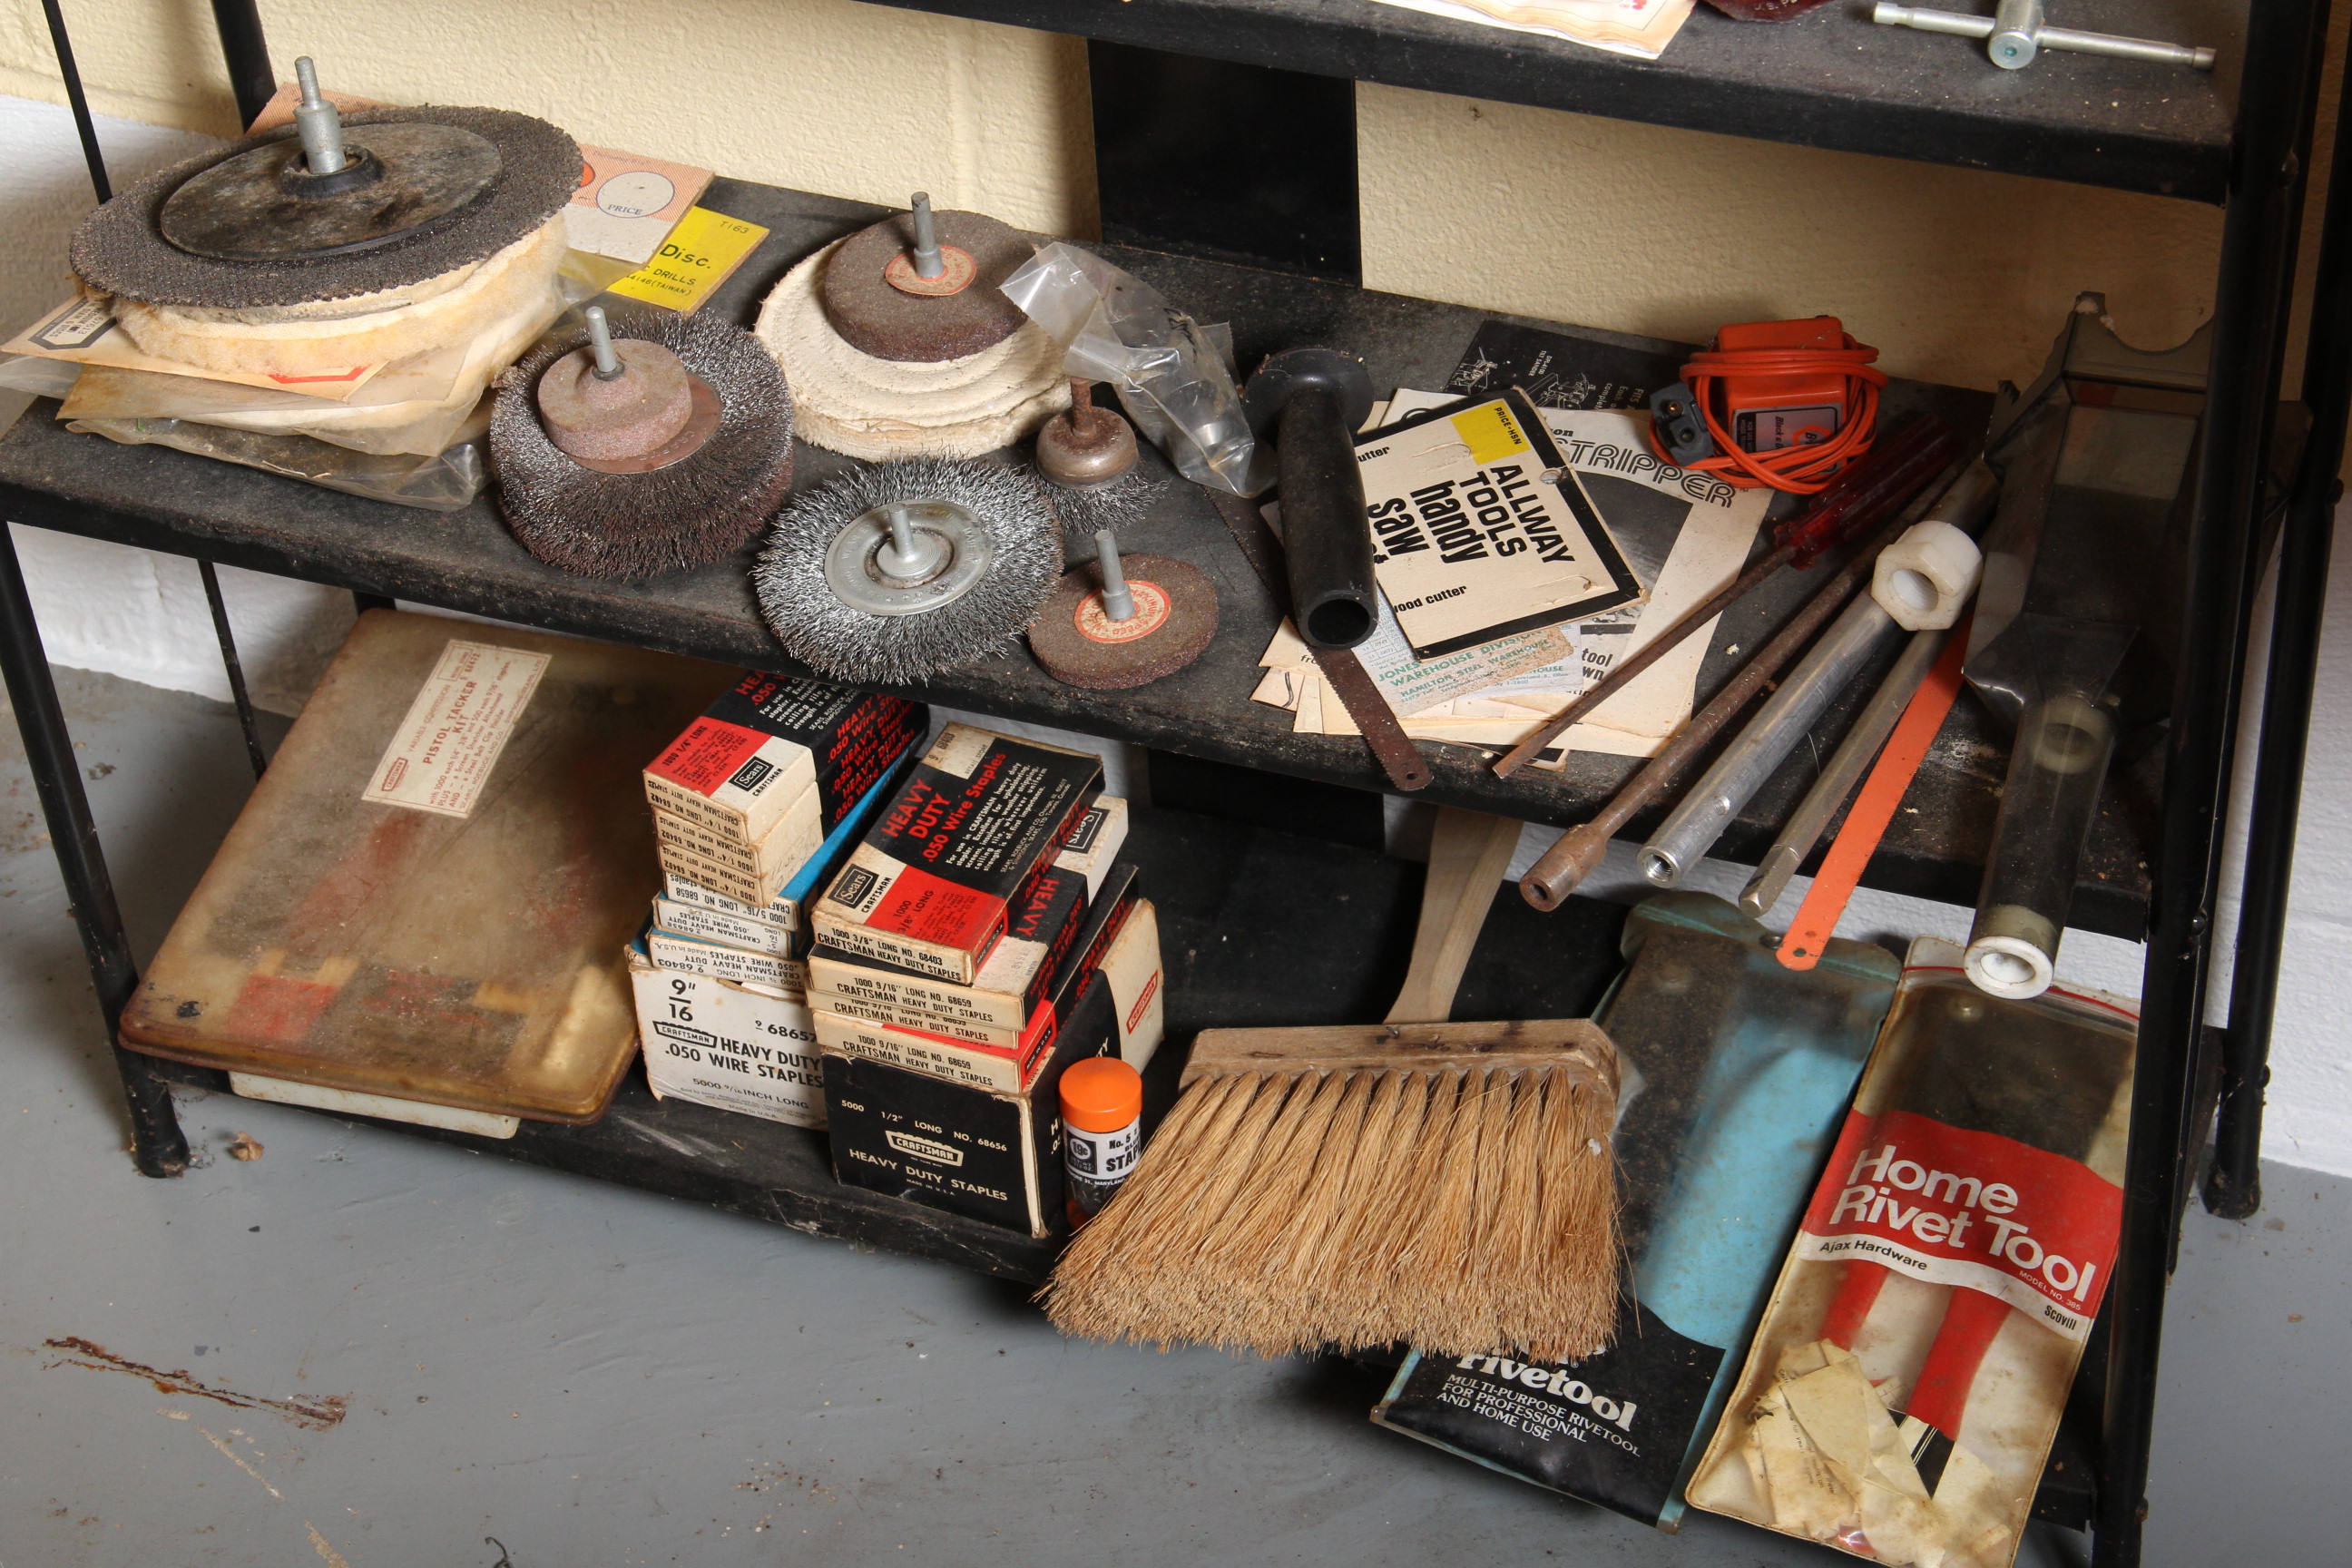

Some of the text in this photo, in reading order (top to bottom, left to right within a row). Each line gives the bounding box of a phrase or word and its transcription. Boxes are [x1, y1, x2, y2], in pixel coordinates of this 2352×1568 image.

[608, 204, 642, 214] PRICE
[720, 221, 749, 233] T163
[660, 244, 710, 269] Disc.
[653, 269, 696, 286] DRILLS
[1367, 498, 1430, 556] saw
[1410, 480, 1489, 564] handy
[1459, 471, 1528, 557] TOOLS
[1490, 465, 1575, 564] ALLWAY
[1426, 585, 1467, 604] cutter
[1112, 620, 1150, 635] SPEED
[1378, 662, 1421, 682] JONES
[1390, 652, 1475, 687] WAREHOUSE
[1400, 674, 1452, 697] HAMILTON
[1457, 664, 1484, 677] STEEL
[1488, 639, 1551, 664] WAREHOUSE
[1582, 648, 1612, 667] tool
[408, 684, 452, 752] VARIABLE COMPRESSION
[422, 681, 477, 764] PISTOL TACKER
[452, 714, 469, 734] KIT
[662, 753, 680, 766] 1000
[690, 726, 708, 740] LONG
[936, 732, 956, 751] 68403
[739, 764, 763, 783] Sears
[752, 769, 784, 797] CRAFTSMAN
[671, 790, 683, 800] DUTY
[687, 796, 701, 808] HEAVY
[881, 779, 933, 838] HEAVY
[927, 753, 1007, 862] .050 Wire Staples
[686, 808, 701, 821] LONG
[703, 804, 740, 827] CRAFTSMAN
[908, 793, 952, 839] DUTY
[724, 826, 740, 838] 1000
[664, 860, 685, 874] 68402
[701, 876, 718, 887] LONG
[719, 868, 755, 889] CRAFTSMAN
[740, 891, 756, 902] 1000
[839, 873, 867, 901] Sears
[861, 877, 893, 914] CRAFTSMAN
[675, 887, 788, 925] 1000 5/16" LONG NO. 68658
[893, 900, 912, 918] 1000
[897, 890, 935, 933] 3/8" LONG
[1016, 878, 1060, 938] HEAVY
[818, 934, 962, 981] CRAFTSMAN HEAVY DUTY STAPLES
[832, 927, 943, 965] 1000 3/8" LONG NO. 68403
[658, 958, 693, 970] 68403
[684, 955, 800, 980] CRAFTSMAN HEAVY DUTY
[671, 979, 696, 995] 9"
[854, 977, 972, 1008] 1000 9/16" LONG NO. 68659
[669, 1004, 693, 1022] 16
[837, 983, 897, 1004] CRAFTSMAN
[901, 997, 926, 1009] HEAVY
[933, 1004, 954, 1014] DUTY
[959, 1008, 994, 1023] STAPLES
[662, 1026, 710, 1044] CRAFTSMAN
[768, 1024, 817, 1043] 68657
[834, 1003, 894, 1023] CRAFTSMAN
[898, 1017, 924, 1028] HEAVY
[929, 1023, 949, 1034] DUTY
[955, 1027, 988, 1042] STAPLES
[665, 1044, 824, 1088] .050 WIRE STAPLES
[720, 1037, 822, 1072] HEAVY DUTY
[843, 1041, 993, 1087] CRAFTSMAN HEAVY DUTY STAPLES
[858, 1034, 972, 1070] 1000 9/16" LONG NO. 68659
[693, 1078, 809, 1109] 5000 INCH LONG
[842, 1100, 1007, 1152] 5000 1/2" LONG NO. 68656
[1109, 1133, 1131, 1150] No. 5
[896, 1137, 955, 1161] CRAFTSMAN
[1105, 1145, 1141, 1172] STAP
[848, 1149, 1008, 1201] HEAVY DUTY STAPLES
[1847, 1144, 2018, 1214] Home
[1819, 1240, 1928, 1271] Ajax Hardware
[1829, 1185, 2096, 1302] Rivet Tool
[2019, 1270, 2082, 1311] MODEL NO. 385
[2043, 1304, 2077, 1331] Scovill
[1436, 1393, 1553, 1442] AND HOME USE
[1442, 1383, 1587, 1443] FOR PROFESSIONAL
[1448, 1374, 1641, 1457] MULTI-PURPOSE RIVETOOL
